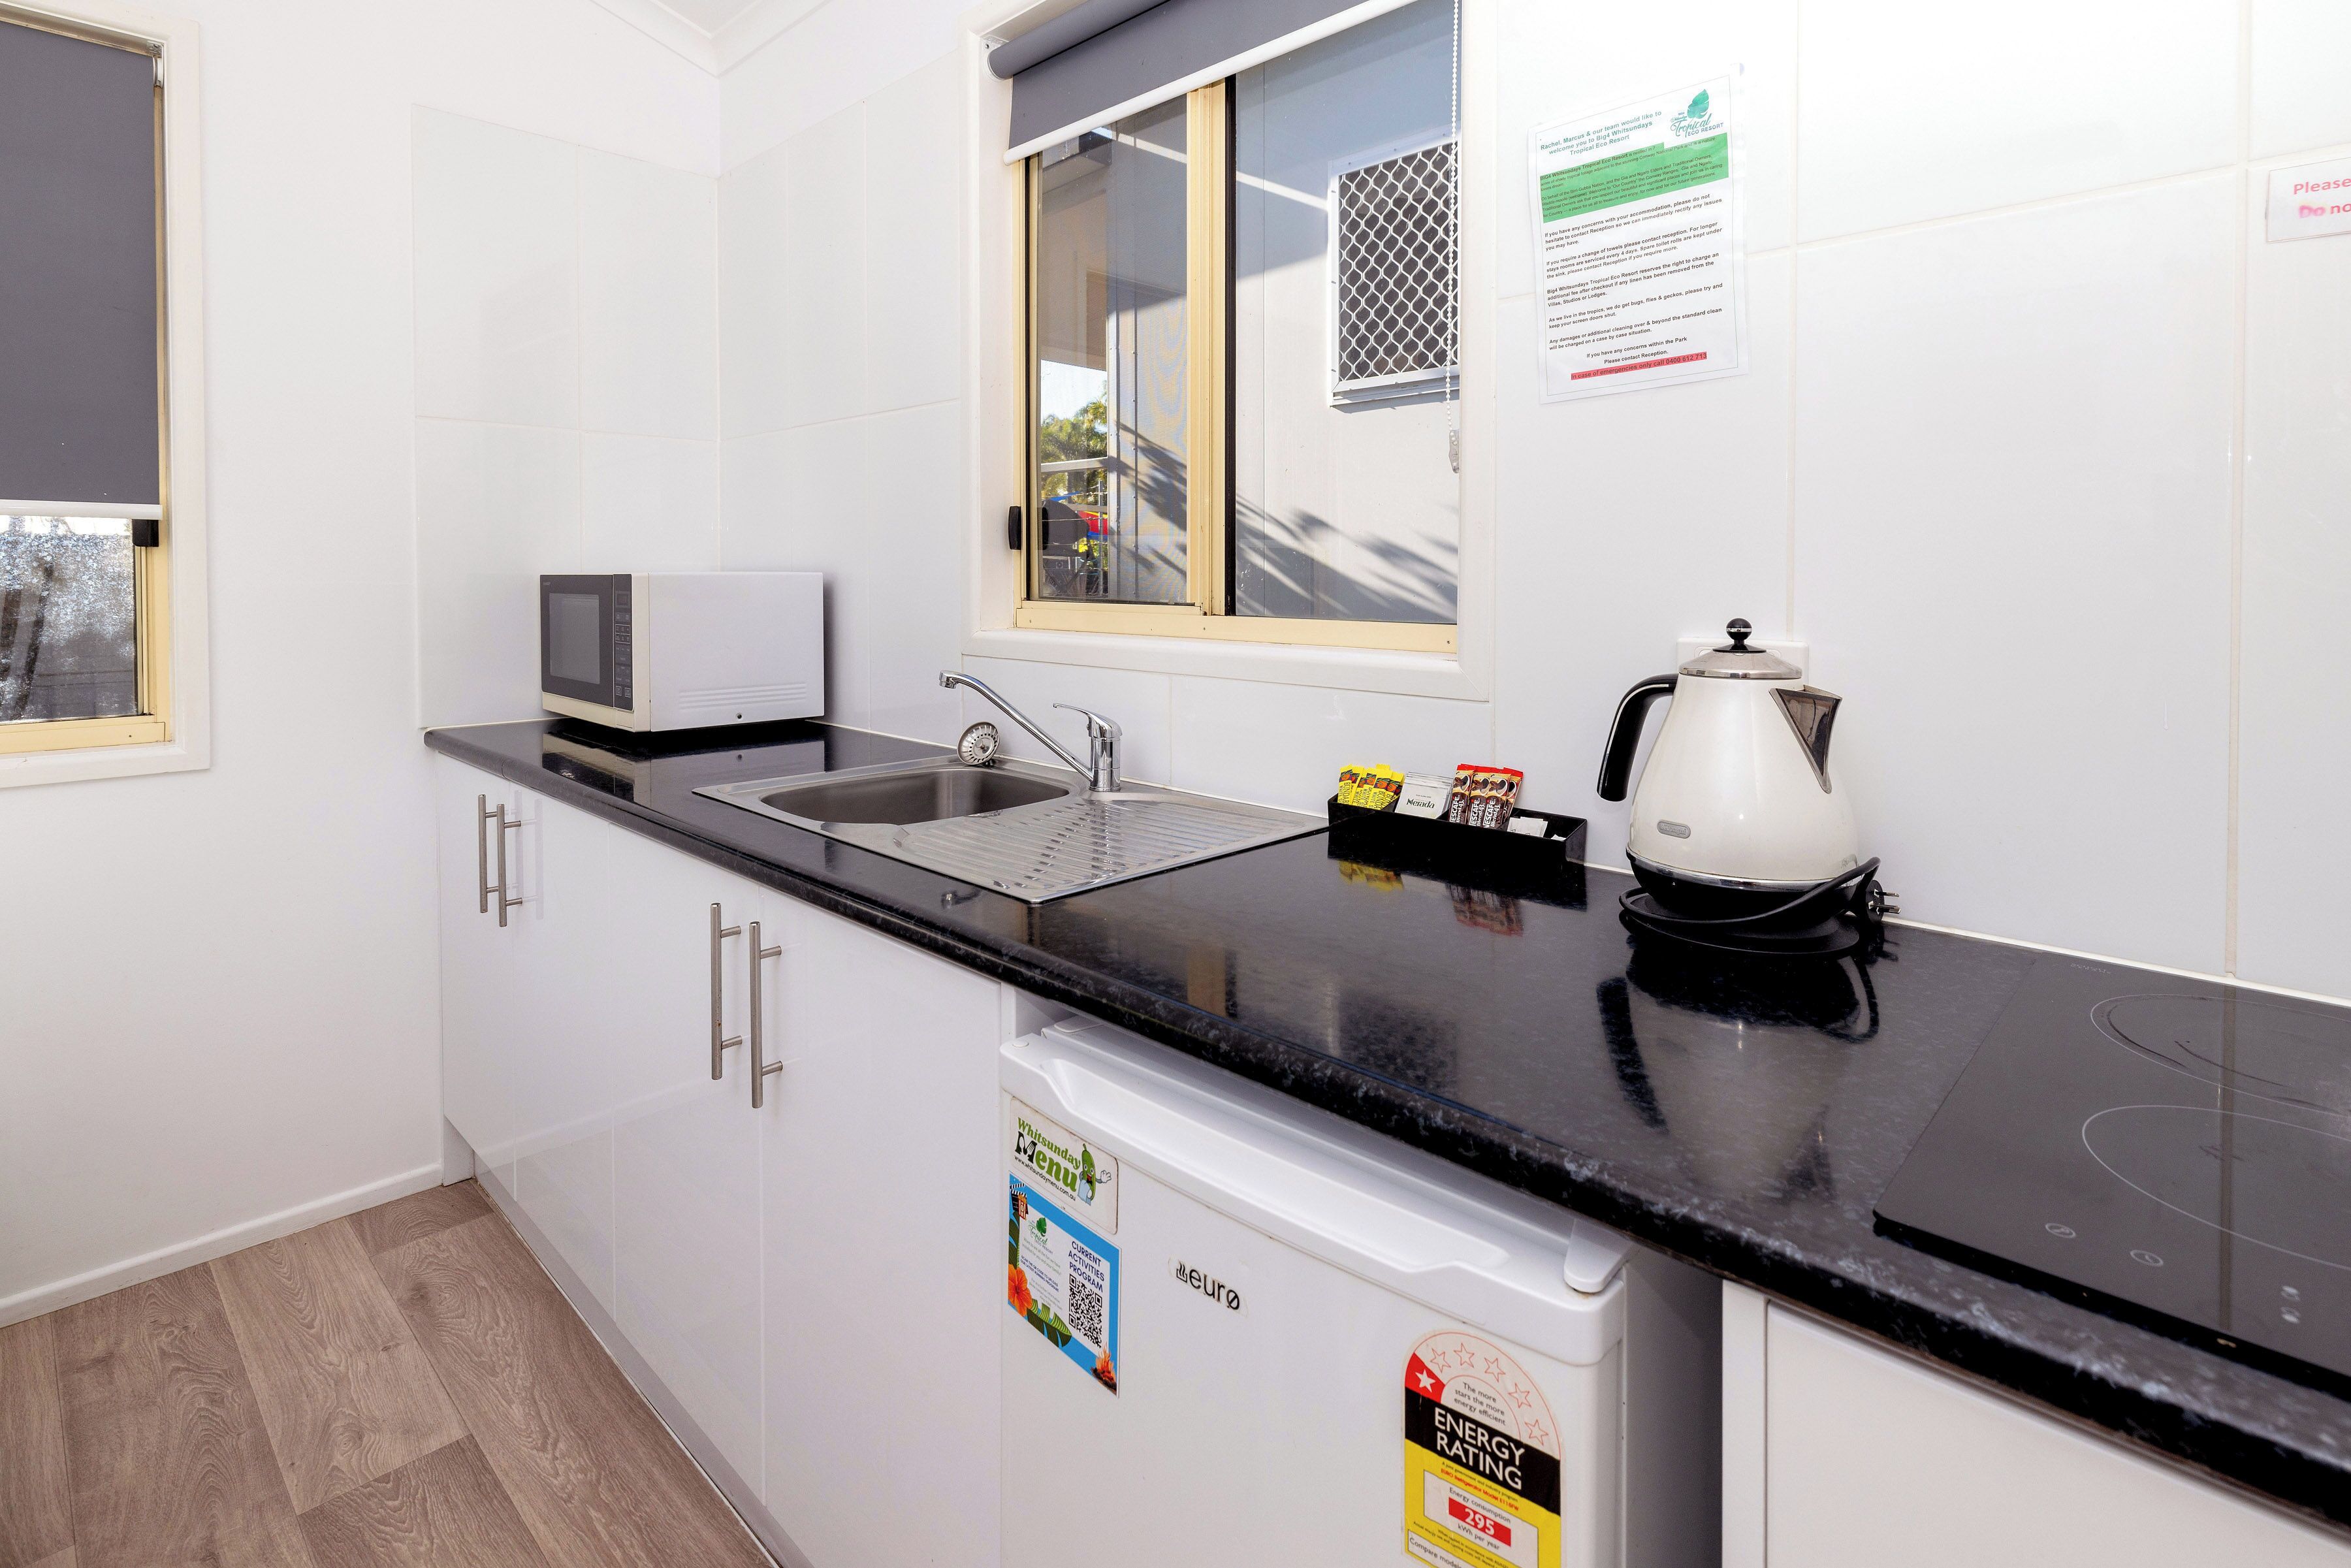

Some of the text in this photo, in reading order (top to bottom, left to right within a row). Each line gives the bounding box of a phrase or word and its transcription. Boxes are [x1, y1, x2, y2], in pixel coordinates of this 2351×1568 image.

[1548, 144, 1574, 154] welcome
[1596, 132, 1610, 141] Big4
[1611, 121, 1652, 136] Whitsundays
[1563, 133, 1584, 143] Marcus
[1604, 123, 1619, 131] team
[1620, 116, 1640, 126] would
[1671, 113, 1712, 138] Tropical
[1701, 123, 1724, 133] RESORT
[1569, 144, 1594, 155] Tropical
[1608, 134, 1629, 144] Resort
[1570, 230, 1589, 238] contact
[1589, 224, 1614, 233] Reception
[1641, 210, 1673, 221] immediately
[1581, 220, 1604, 229] concerns
[1673, 199, 1691, 207] please
[2299, 205, 2326, 218] Do
[1587, 328, 1611, 337] additional
[1651, 316, 1671, 324] beyond
[1681, 310, 1705, 319] standard
[1599, 365, 1637, 375] emergencies
[1406, 798, 1435, 808] Nerada
[1018, 1117, 1080, 1170] Whitsunday
[1015, 1131, 1077, 1192] Menu
[1014, 1155, 1076, 1201] www.whitsundaymenu.com.au
[1068, 1250, 1104, 1281] ACTIVITIES
[1072, 1241, 1101, 1267] CURRENT
[1069, 1262, 1103, 1292] PROGRAM
[1455, 1389, 1505, 1416] stars the more
[1462, 1382, 1496, 1402] The more
[1454, 1398, 1506, 1425] energy efficient
[1435, 1407, 1525, 1466] ENERGY
[1437, 1430, 1522, 1490] RATING
[1450, 1487, 1511, 1524] Energy consumption
[1465, 1508, 1495, 1535] 295
[1410, 1537, 1438, 1557] Compare
[1458, 1523, 1500, 1550] kWh per year
